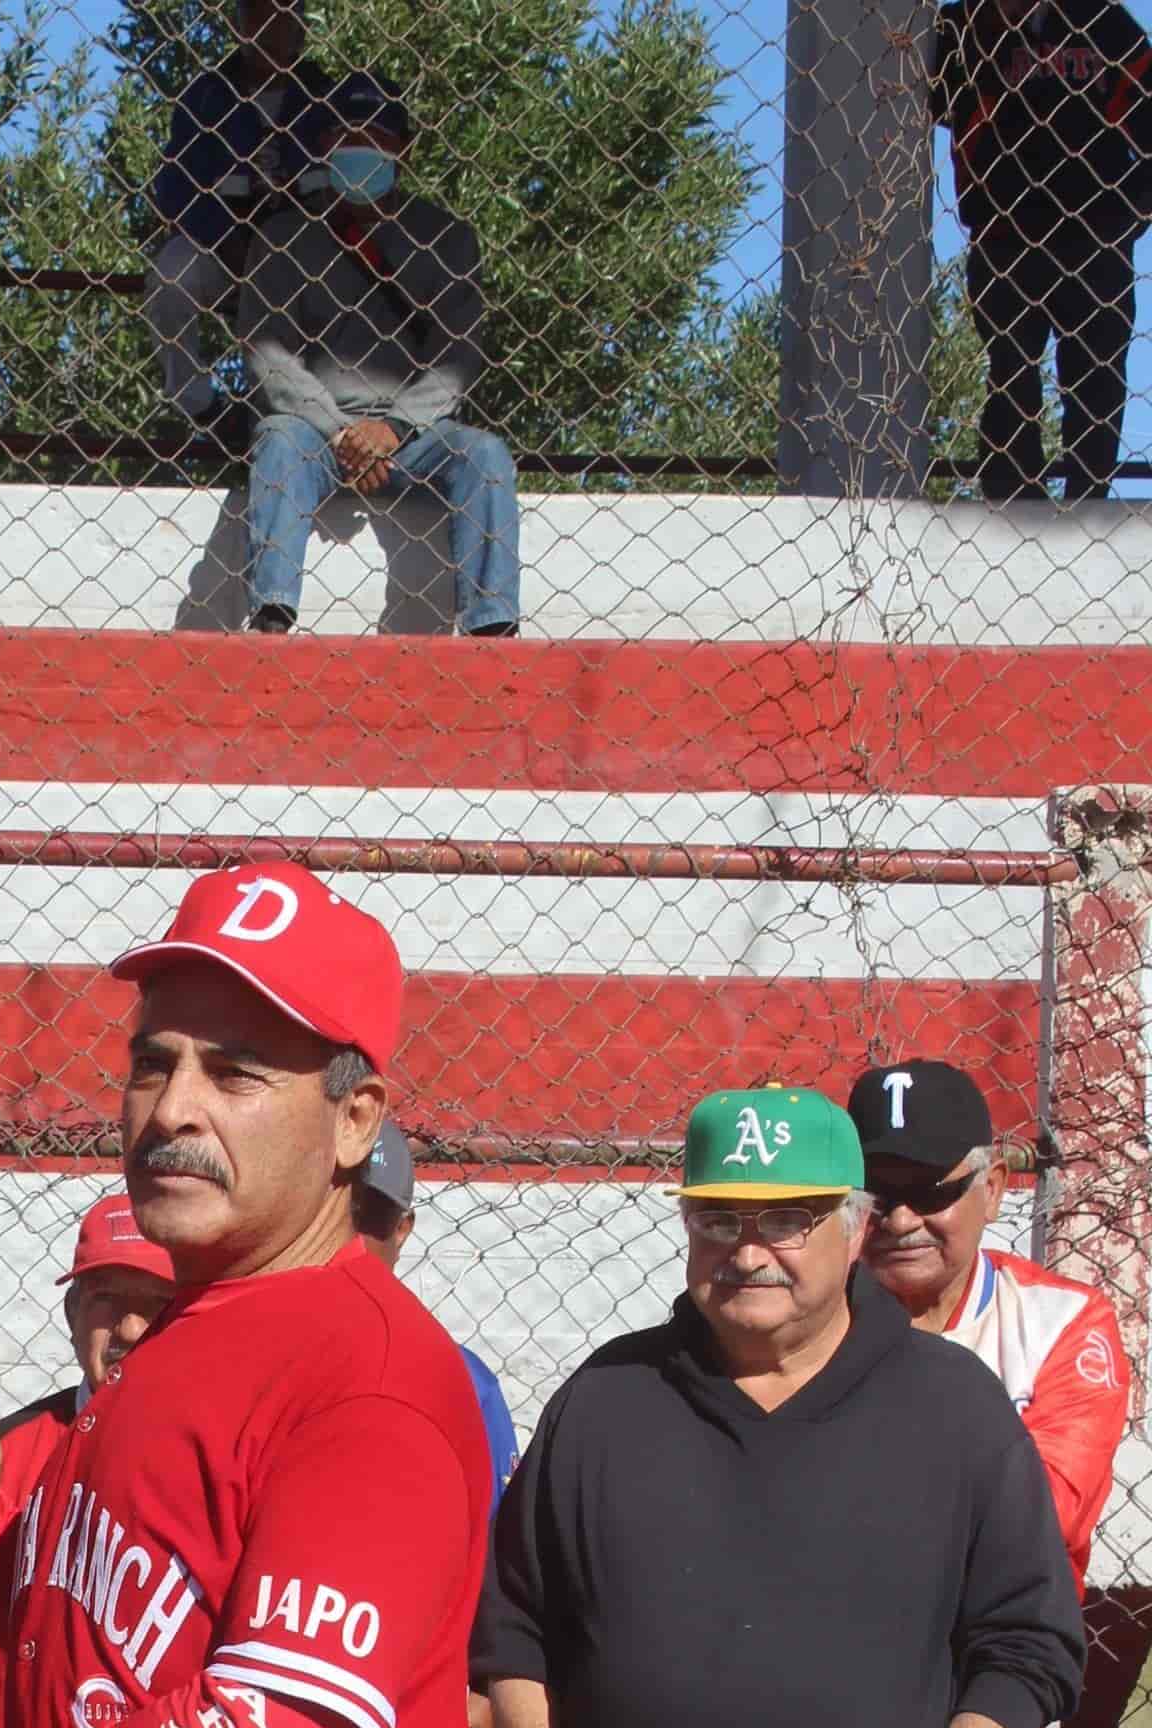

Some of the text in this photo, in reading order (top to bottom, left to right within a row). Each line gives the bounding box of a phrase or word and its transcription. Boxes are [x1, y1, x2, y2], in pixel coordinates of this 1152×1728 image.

[218, 874, 299, 942] D
[882, 1072, 913, 1129] T
[722, 1106, 792, 1167] A's
[248, 1574, 381, 1659] JAPO
